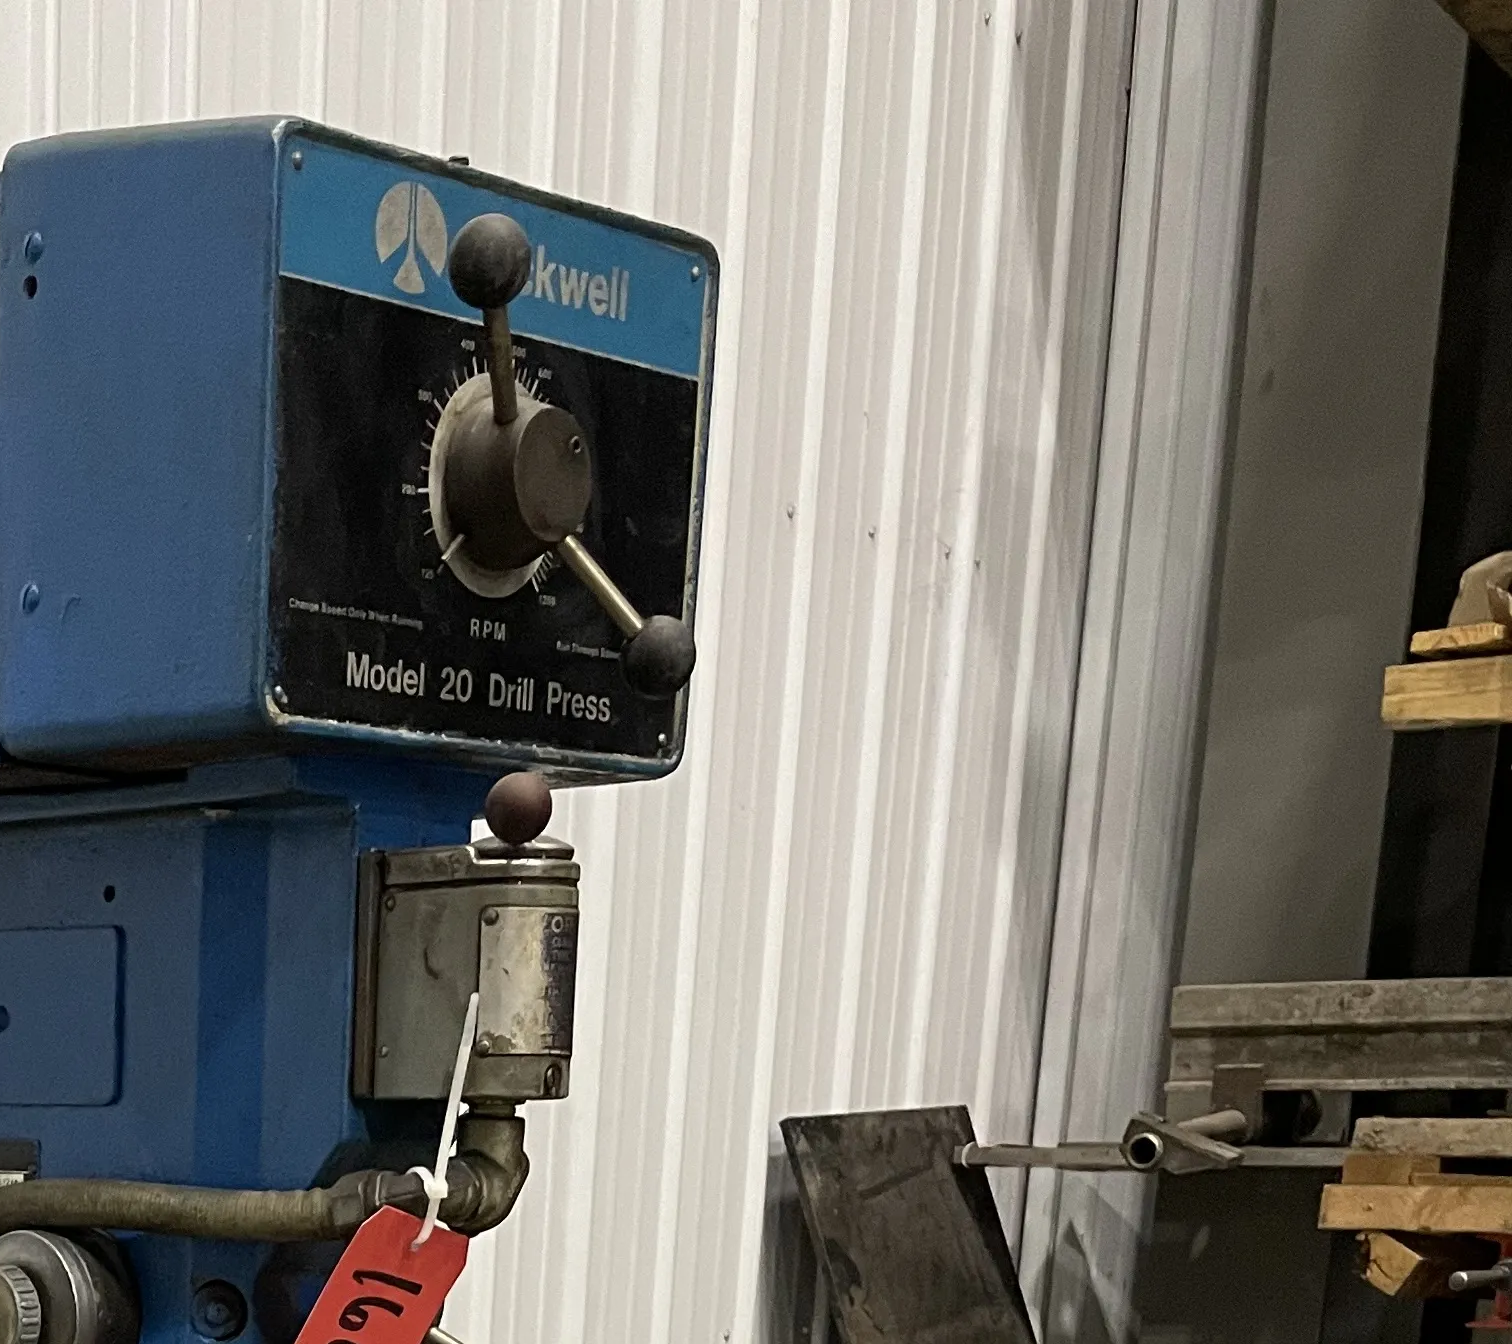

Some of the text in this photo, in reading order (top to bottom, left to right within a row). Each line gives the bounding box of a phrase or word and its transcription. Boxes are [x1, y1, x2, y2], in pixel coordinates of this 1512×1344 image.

[522, 243, 630, 322] kwell
[469, 617, 507, 641] RPM
[346, 651, 612, 723] Model 20 Drill Press
